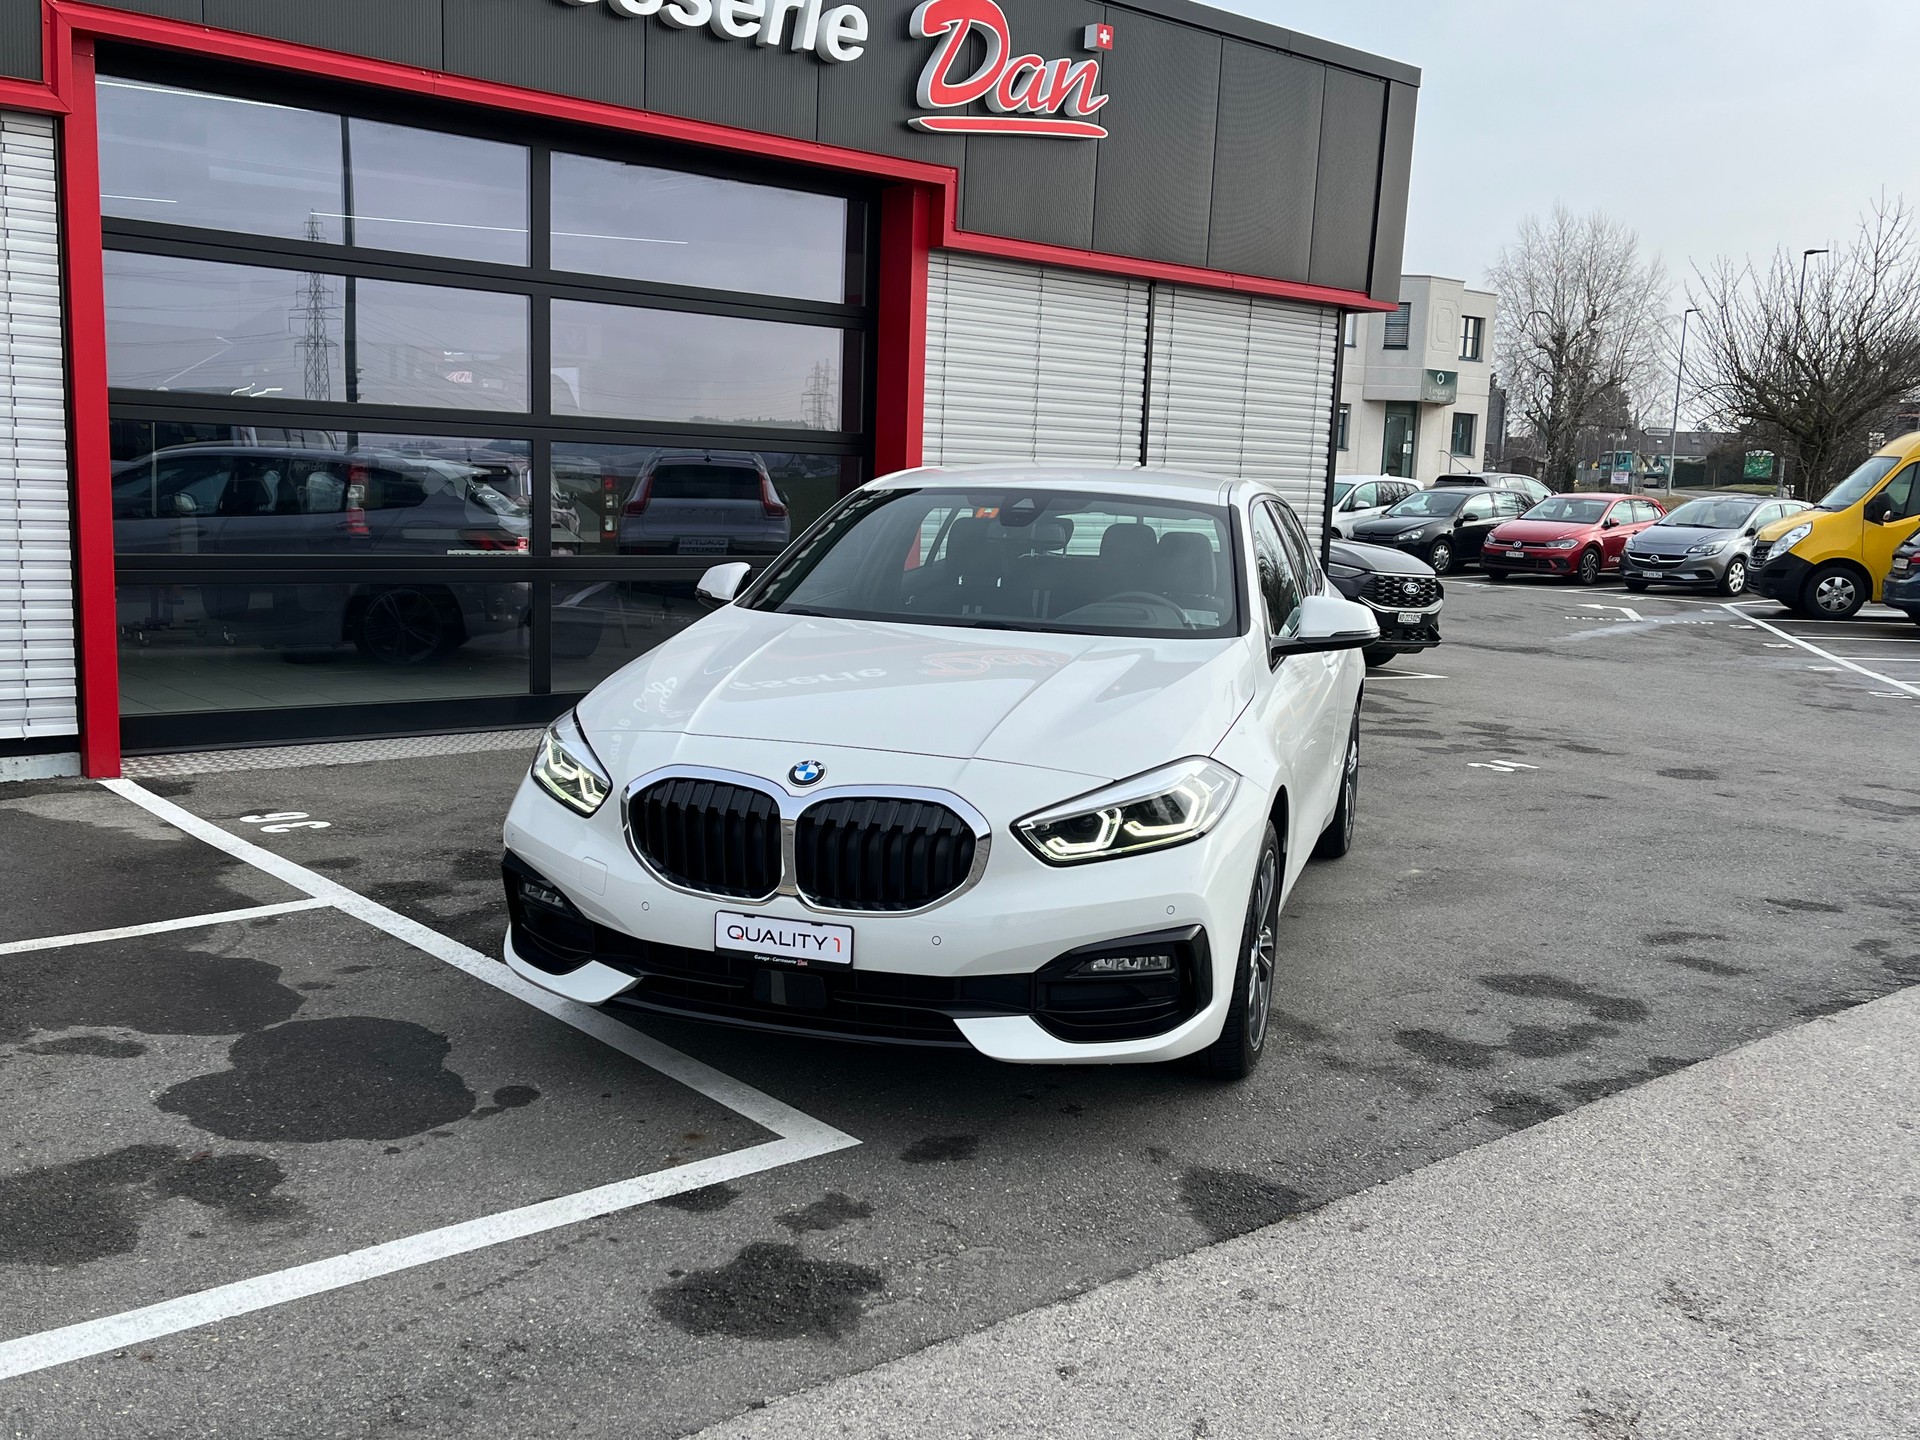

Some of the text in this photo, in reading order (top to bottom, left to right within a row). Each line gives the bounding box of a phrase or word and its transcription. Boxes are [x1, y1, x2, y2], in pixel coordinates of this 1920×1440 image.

[909, 0, 1110, 117] Dan
[727, 925, 841, 953] QUALITY 1
